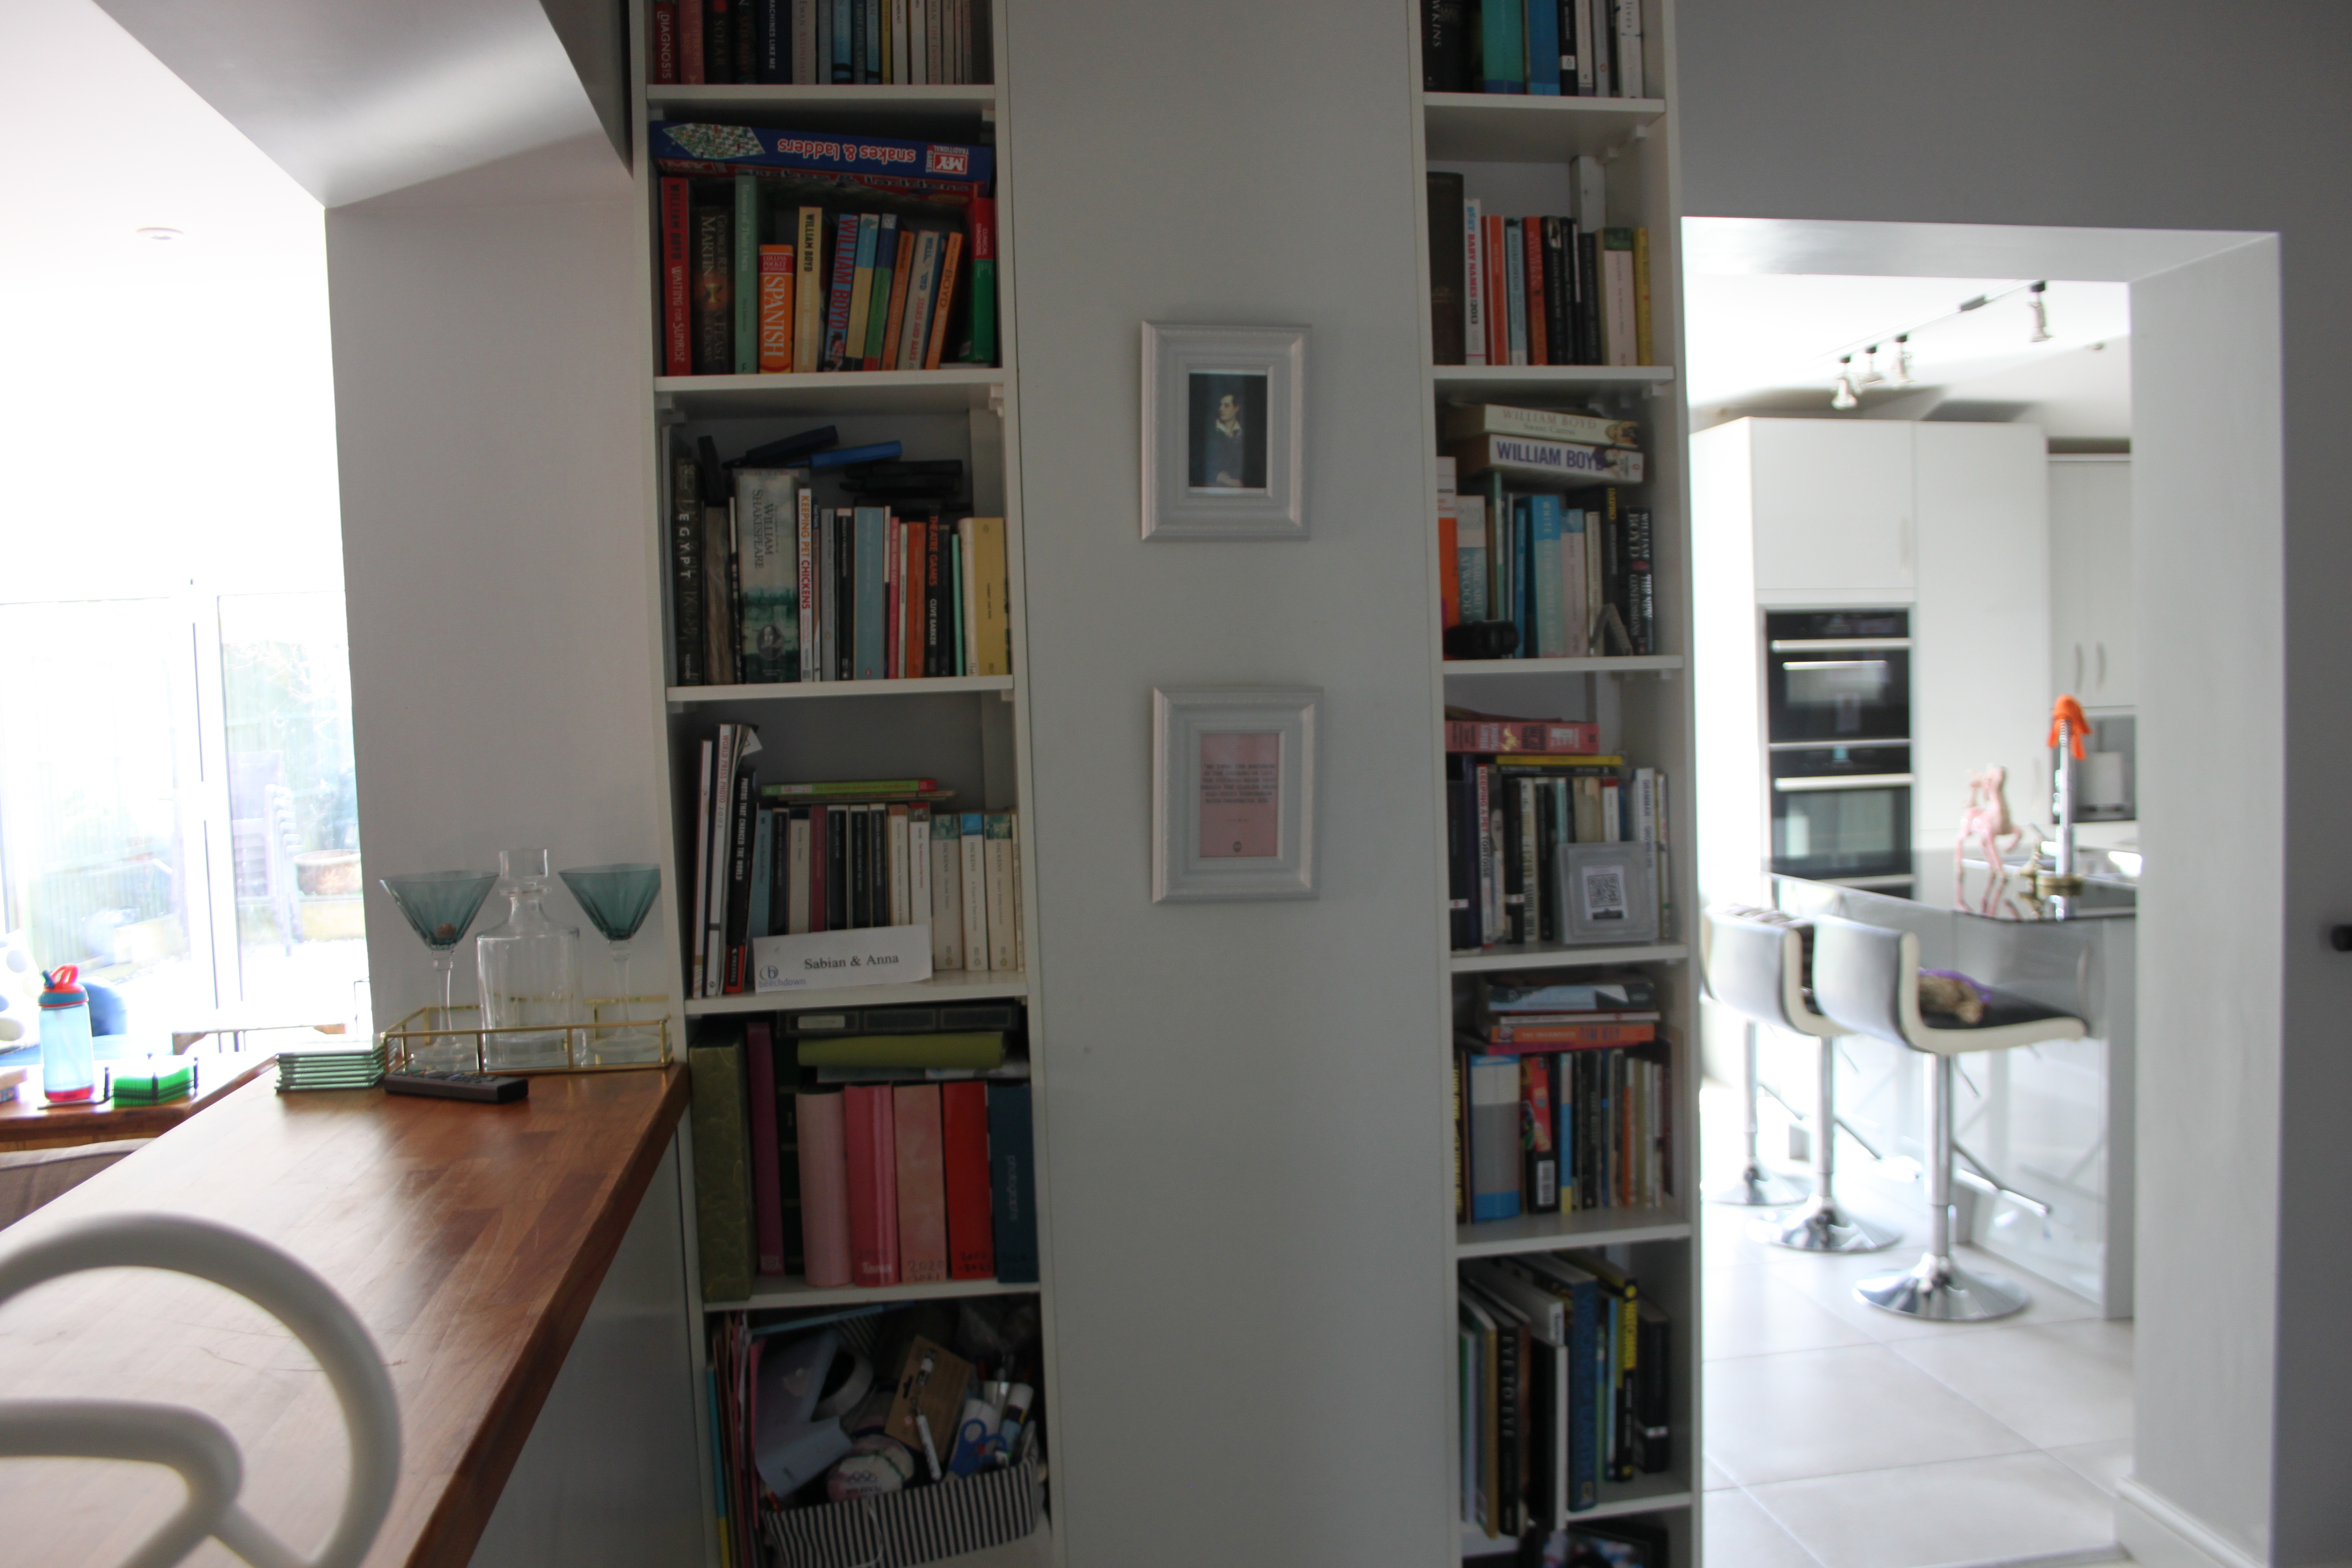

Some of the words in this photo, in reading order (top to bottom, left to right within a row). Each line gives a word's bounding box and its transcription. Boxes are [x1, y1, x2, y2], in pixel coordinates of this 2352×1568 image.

[660, 14, 671, 79] DIAGNOSIS
[714, 19, 725, 66] SOLAR
[769, 58, 776, 69] ME
[777, 138, 841, 158] ladders
[844, 147, 856, 162] &
[859, 146, 916, 163] snakes
[669, 184, 681, 229] WILLIAM
[670, 233, 682, 260] BOYD
[701, 215, 716, 278] MARTIN
[717, 215, 727, 255] GEORGE
[804, 214, 814, 248] WILLIAM
[1468, 234, 1476, 261] BABY
[803, 250, 813, 272] BOYD
[833, 218, 858, 284] WILLIAM
[671, 266, 683, 306] WAITING
[939, 268, 953, 308] BOYD
[1469, 262, 1477, 297] NAMES
[763, 276, 785, 357] SPANISH
[829, 289, 850, 330] BOYD
[914, 296, 926, 320] STARS
[672, 323, 685, 362] SUNRISE
[703, 327, 714, 363] CROWS
[714, 322, 726, 361] FEAST
[911, 322, 922, 339] AND
[909, 340, 919, 361] BARS
[1503, 409, 1556, 425] WILLIAM
[1562, 416, 1597, 429] BOYD
[1496, 441, 1561, 466] WILLIAM
[1566, 449, 1605, 471] BOYD
[801, 495, 811, 538] KEEPING
[1542, 500, 1552, 534] WHITE
[1607, 487, 1617, 520] IMPRO
[677, 512, 691, 580] EGYPT
[752, 489, 764, 569] SHAKESPEARE
[763, 503, 775, 555] WILLIAM
[928, 515, 938, 552] THEATRE
[1628, 513, 1640, 558] BOYD
[1641, 512, 1650, 560] WILLIAM
[801, 541, 810, 557] PET
[801, 560, 810, 609] CHICKENS
[929, 554, 938, 586] GAMES
[1461, 553, 1473, 615] ATWOOD
[1472, 553, 1483, 614] MARGARET
[720, 735, 729, 758] WORLD
[718, 782, 727, 803] PHOTO
[740, 778, 748, 801] PHOTOS
[737, 818, 746, 845] CHANGED
[735, 860, 744, 881] WORLD
[803, 956, 846, 970] Sabian
[850, 955, 861, 966] &
[866, 954, 898, 965] Anna
[1501, 1336, 1515, 1367] EYE
[1501, 1406, 1515, 1436] EYE
